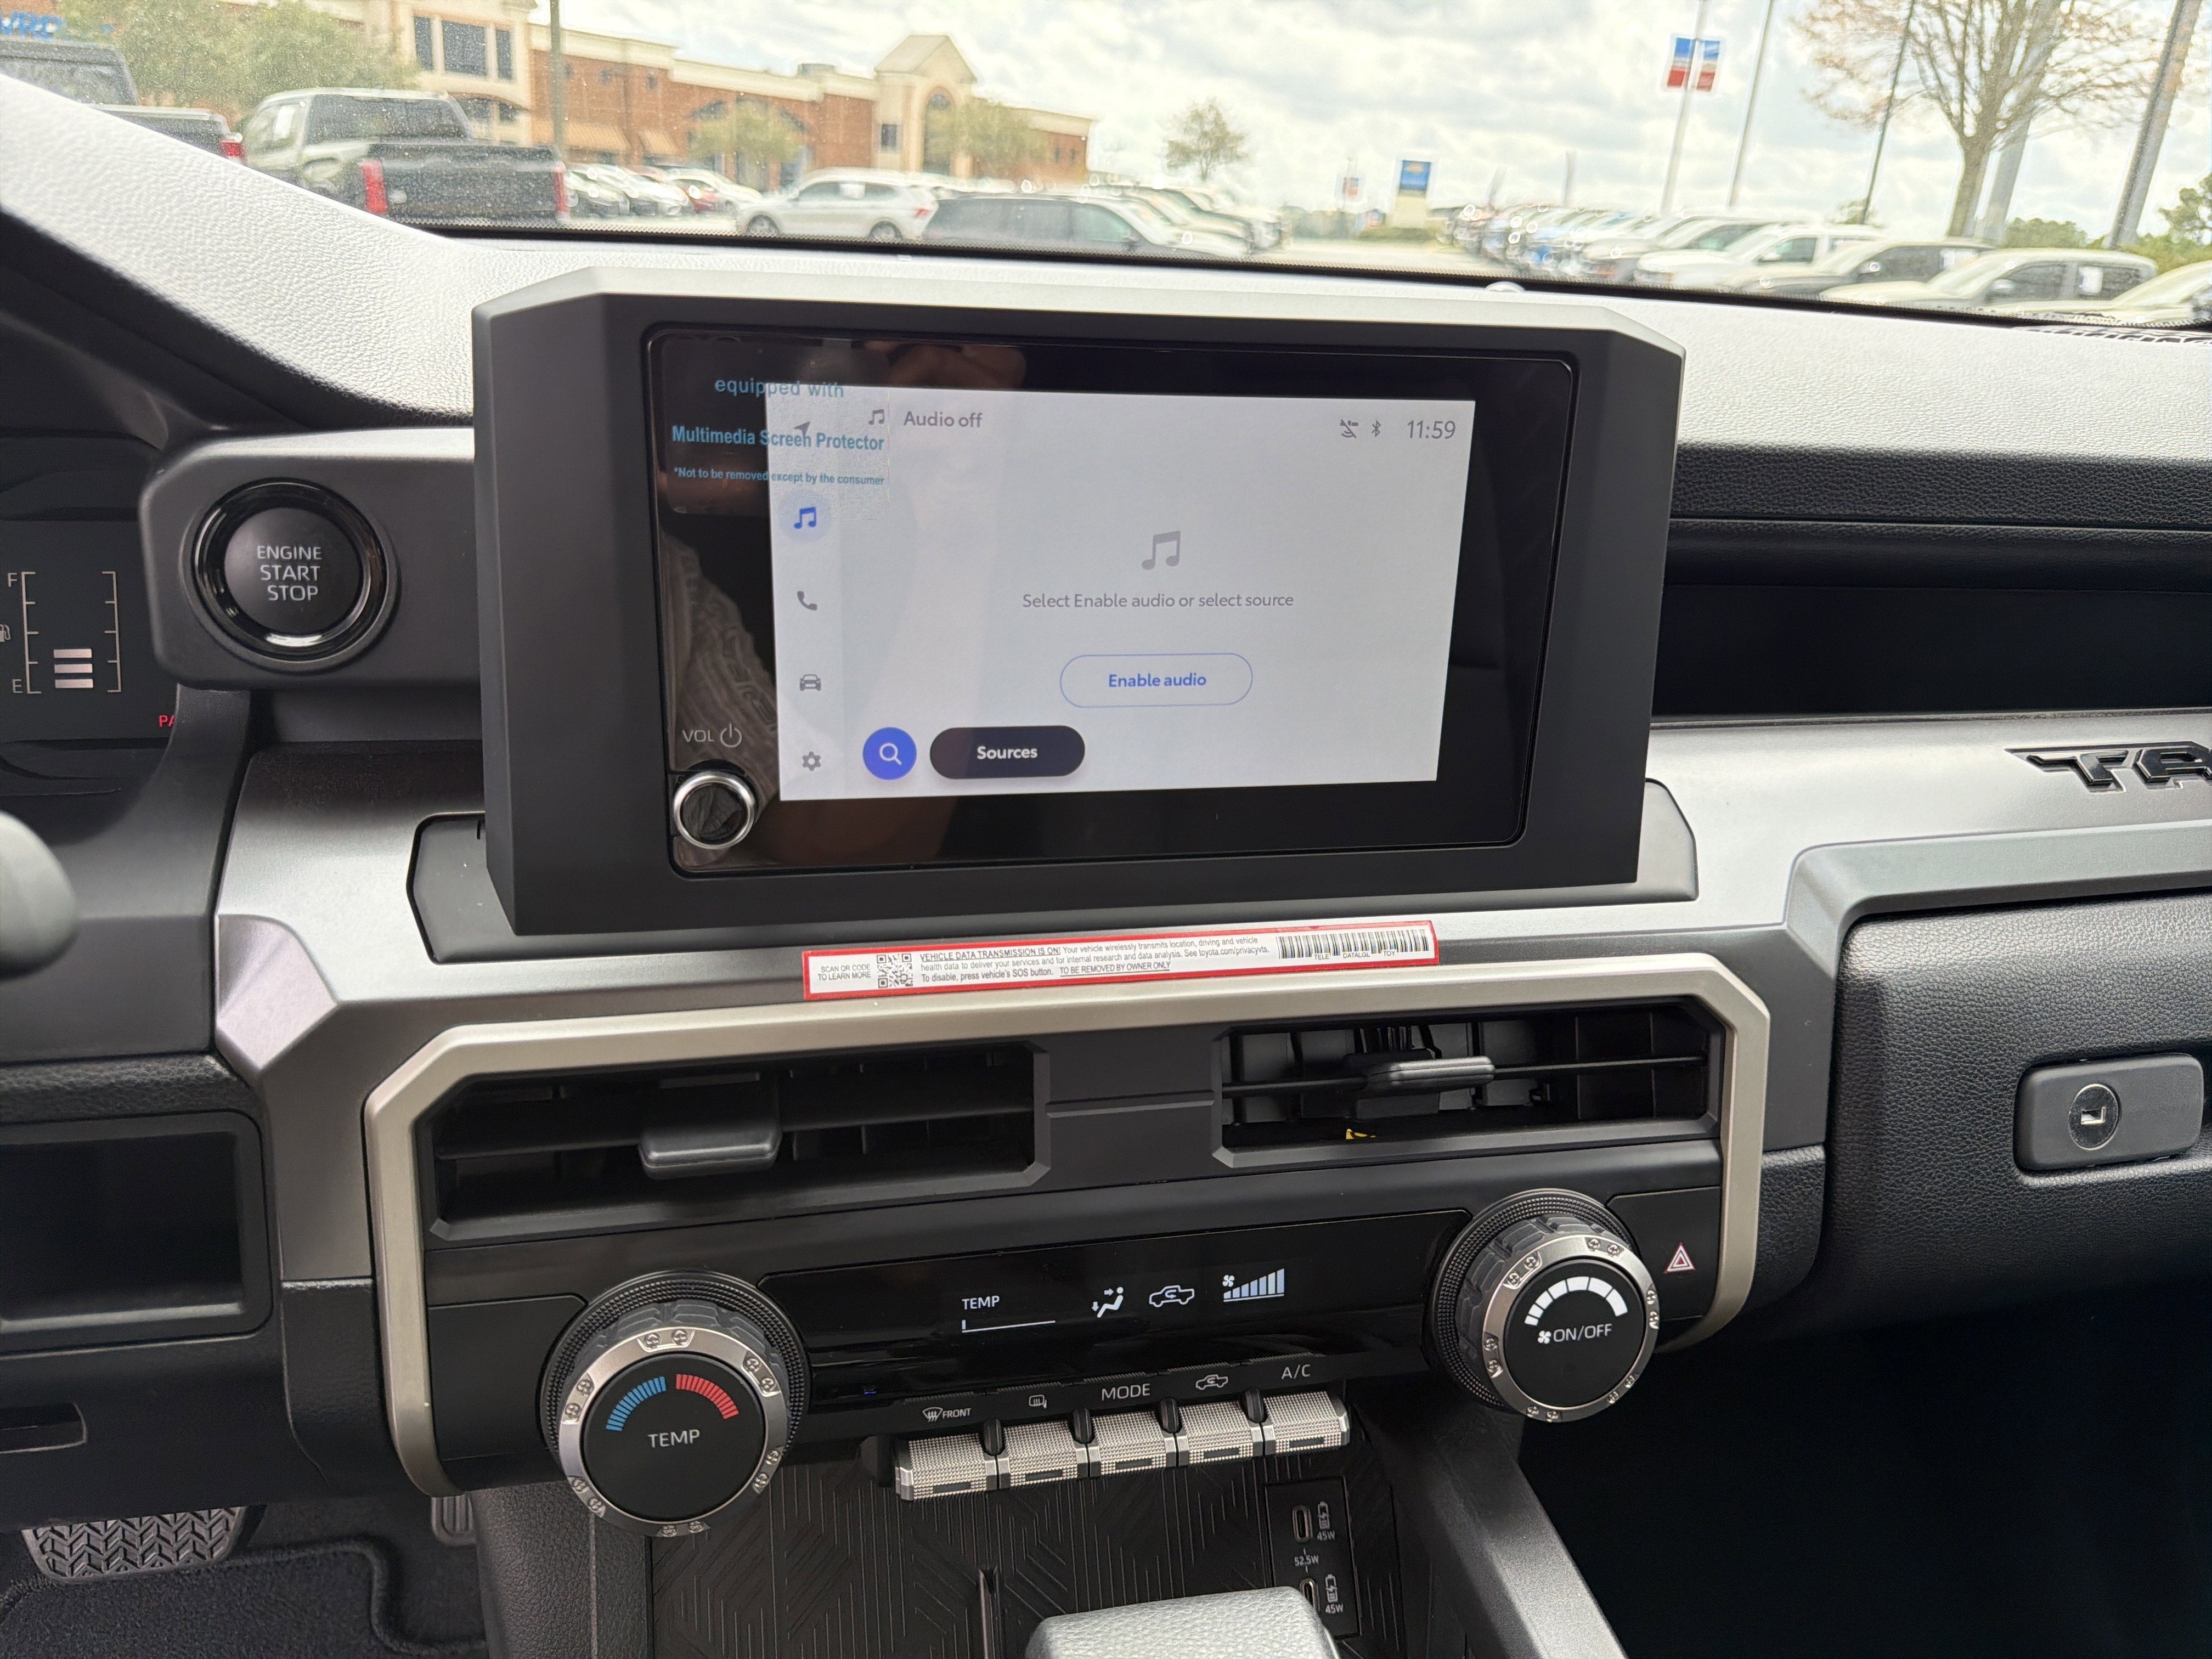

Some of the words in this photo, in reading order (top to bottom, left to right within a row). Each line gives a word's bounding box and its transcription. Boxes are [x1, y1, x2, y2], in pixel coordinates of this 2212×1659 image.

[715, 378, 800, 397] equipped
[808, 381, 844, 398] with
[904, 411, 955, 426] Audio
[958, 412, 983, 427] off
[672, 425, 755, 445] Multimedia
[760, 430, 811, 448] Screen
[816, 432, 884, 450] Protector
[1408, 420, 1455, 439] 11:59
[698, 469, 708, 478] to
[711, 469, 723, 479] be
[726, 470, 768, 481] removed
[771, 472, 804, 484] except
[806, 473, 817, 485] by
[820, 473, 834, 483] the
[837, 476, 884, 485] consumer
[257, 545, 323, 560] ENGINE
[8, 572, 18, 587] F
[260, 565, 320, 581] START
[267, 585, 318, 601] STOP
[1023, 594, 1070, 608] Select
[1074, 594, 1127, 608] Enable
[1131, 592, 1175, 607] audio
[1179, 597, 1194, 607] or
[1199, 592, 1242, 607] select
[1245, 596, 1294, 606] source
[12, 679, 22, 693] E
[1109, 673, 1160, 687] Enable
[1164, 672, 1206, 686] audio
[682, 730, 714, 742] VOL
[977, 746, 1038, 760] Sources
[920, 952, 953, 962] VEHICLE
[956, 951, 977, 960] DATA
[978, 948, 1036, 959] TRANSMISSION
[1080, 945, 1103, 953] vehicle
[1105, 943, 1137, 952] wirelessly
[1139, 941, 1168, 950] transmits
[1170, 940, 1197, 949] location,
[1199, 939, 1220, 947] driving
[1235, 936, 1258, 945] vehicle
[921, 963, 943, 972] health
[944, 962, 960, 970] data
[961, 961, 968, 969] to
[970, 960, 993, 969] deliver
[995, 960, 1010, 969] your
[1012, 958, 1040, 967] services
[1066, 955, 1091, 963] internal
[1093, 953, 1122, 962] research
[1154, 950, 1183, 960] analysis.
[1184, 949, 1198, 957] See
[821, 965, 839, 973] SCAN
[828, 972, 850, 980] LEARN
[921, 974, 930, 982] To
[932, 972, 958, 982] disable,
[961, 972, 979, 983] press
[981, 969, 1011, 979] vehicle's
[1012, 968, 1029, 977] SOS
[1030, 968, 1053, 977] button.
[1070, 966, 1080, 974] BE
[1081, 964, 1115, 973] REMOVED
[1116, 963, 1125, 971] BY
[1126, 962, 1152, 970] OWNER
[1153, 961, 1171, 969] ONLY
[962, 1295, 1000, 1310] TEMP
[1554, 1323, 1612, 1343] ON/OFF
[1281, 1364, 1311, 1380] A/C
[1102, 1383, 1151, 1401] MODE
[942, 1408, 971, 1419] FRONT
[648, 1429, 701, 1448] TEMP
[1317, 1530, 1335, 1542] 45W
[1294, 1555, 1319, 1567] 52.5W
[1325, 1603, 1344, 1615] 45W
